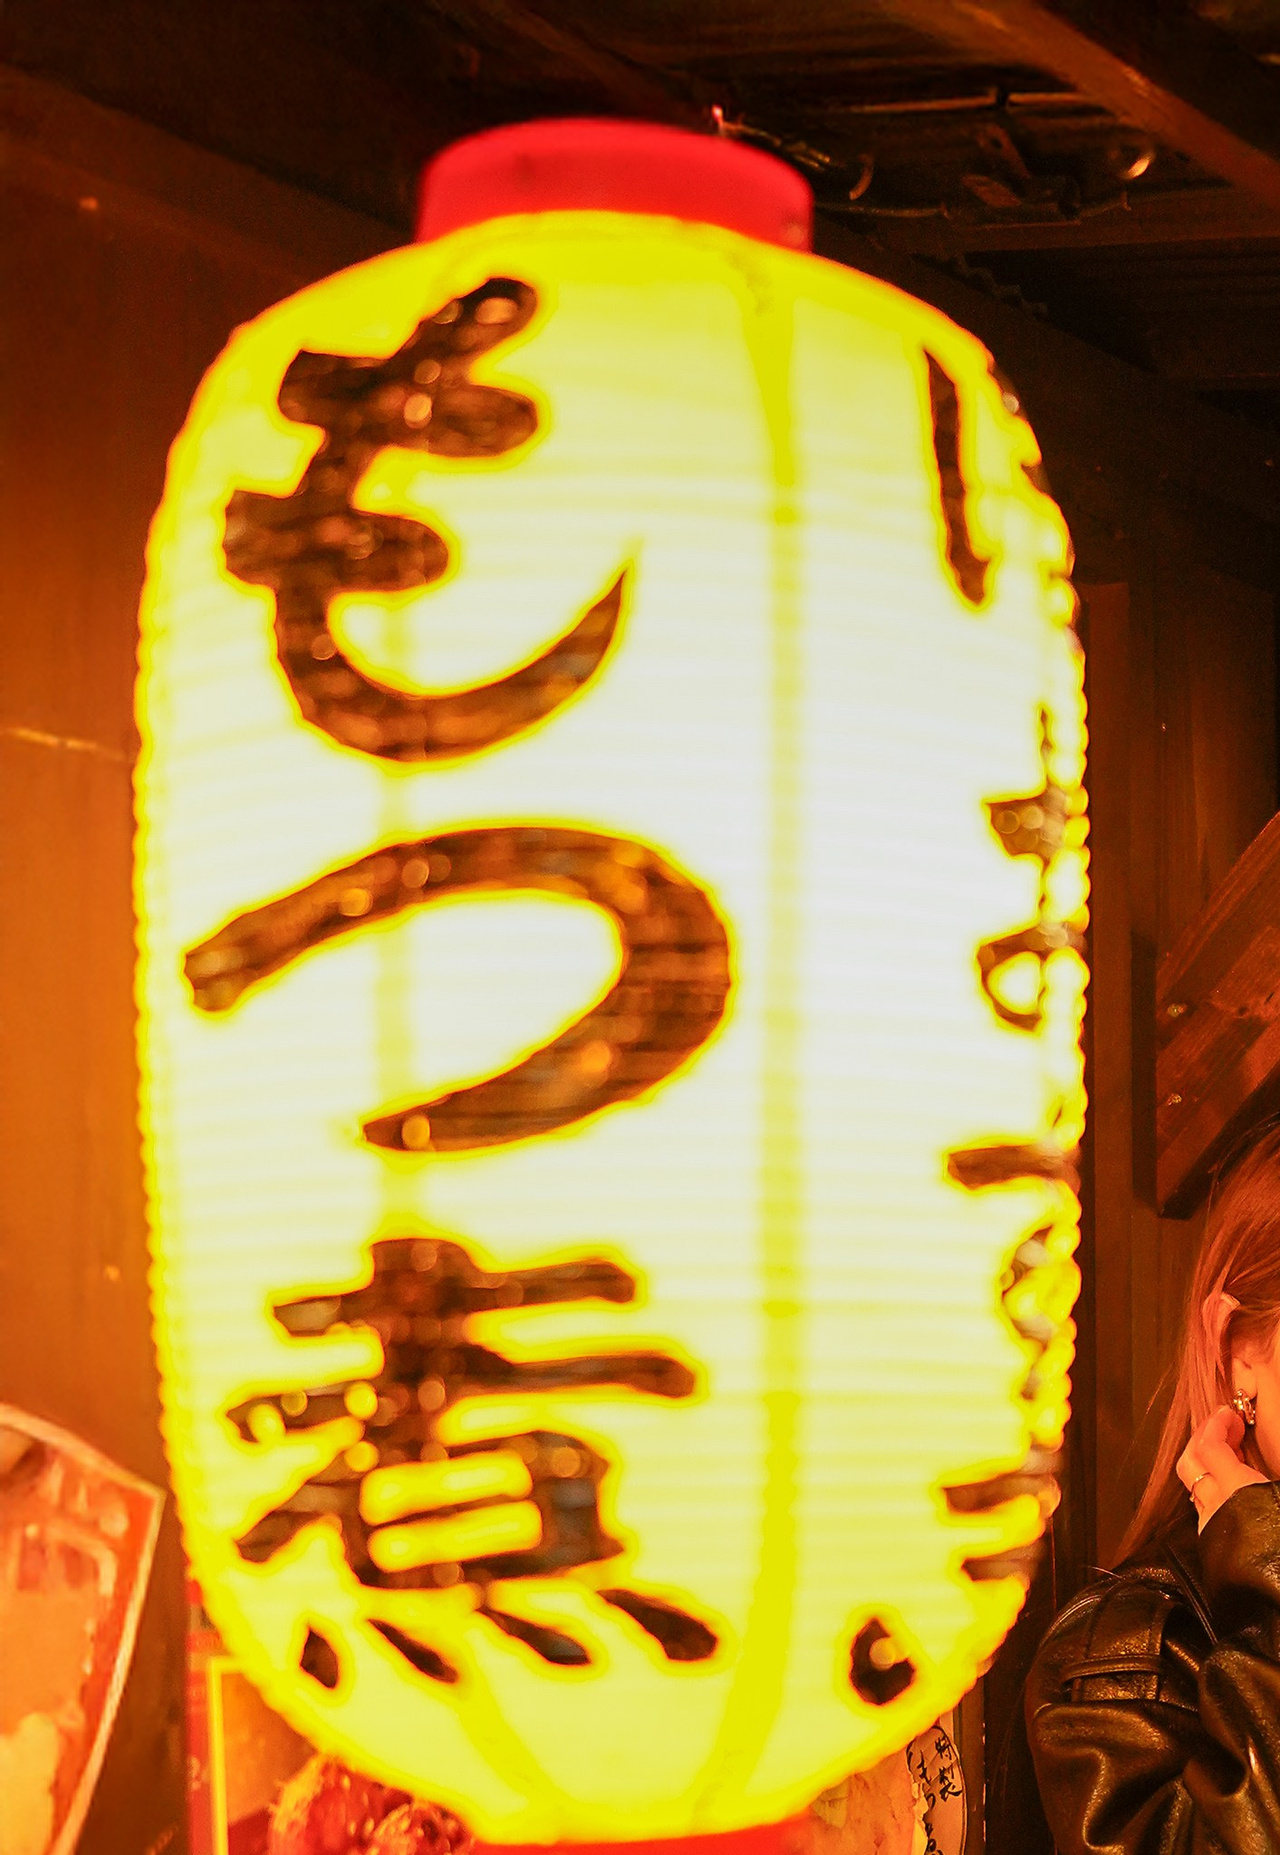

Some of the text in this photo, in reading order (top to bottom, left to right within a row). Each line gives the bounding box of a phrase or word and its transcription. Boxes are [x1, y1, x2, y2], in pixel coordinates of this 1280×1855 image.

[184, 277, 733, 1684] もつ煮
[934, 1737, 963, 1801] 特製
